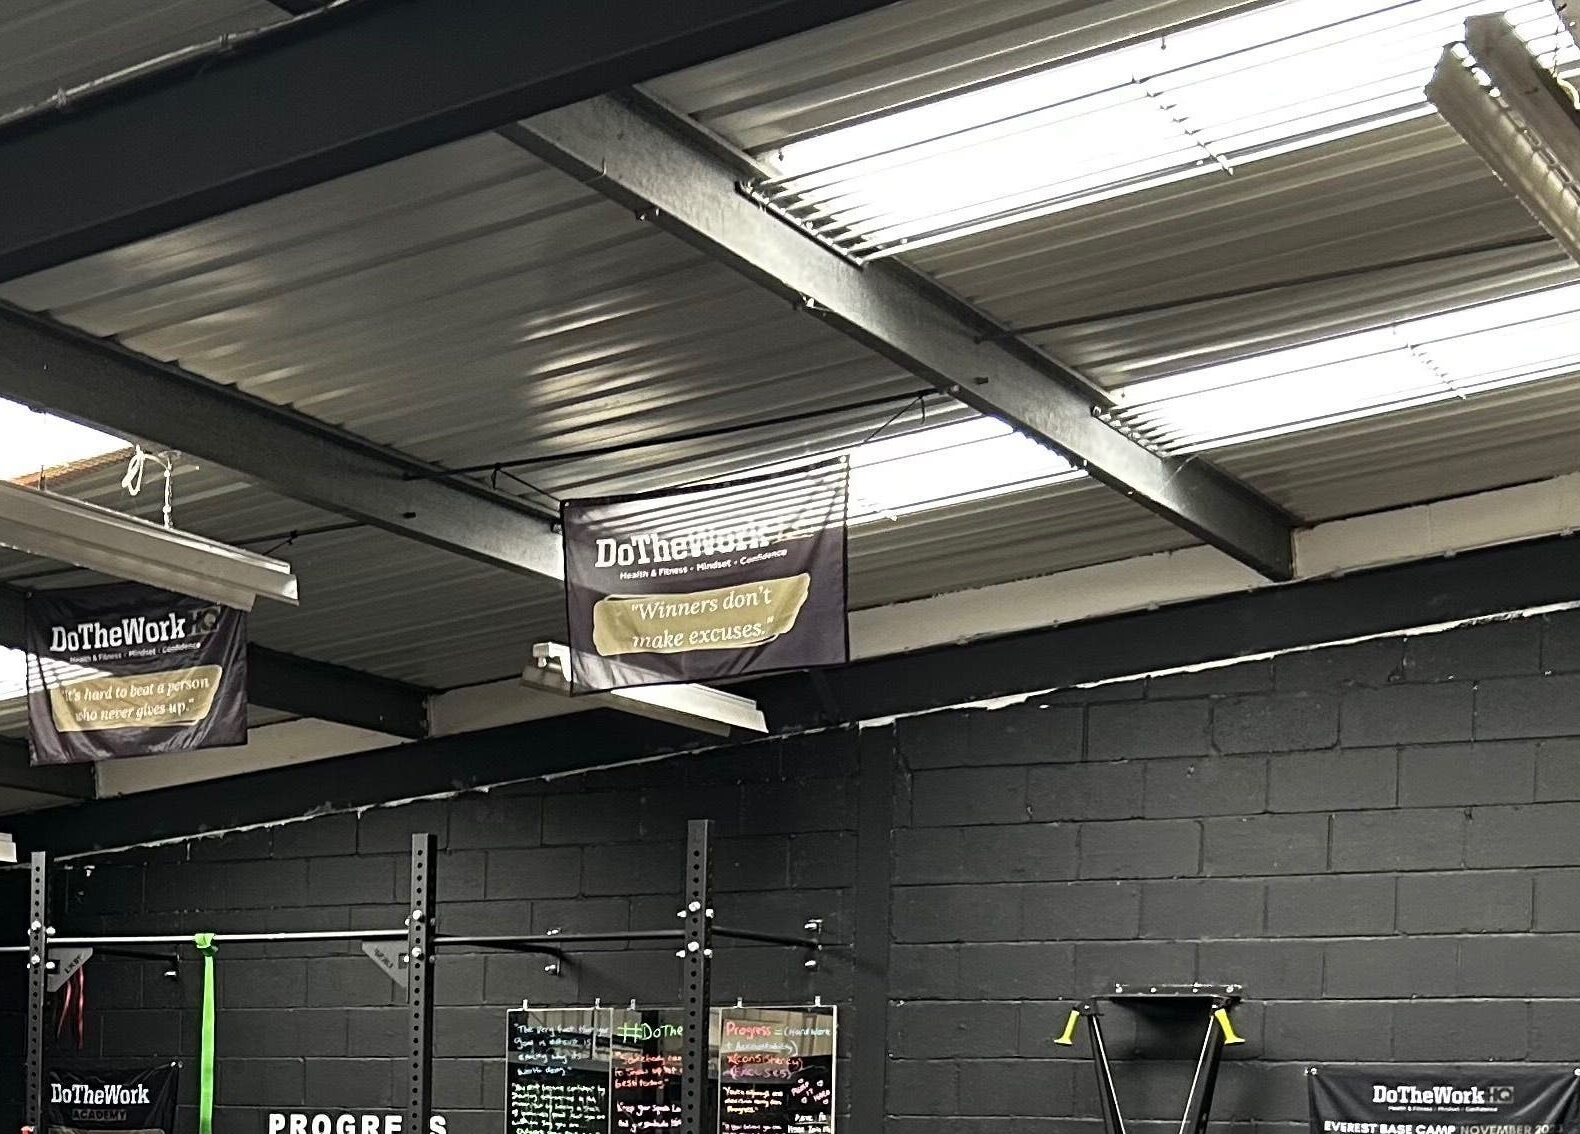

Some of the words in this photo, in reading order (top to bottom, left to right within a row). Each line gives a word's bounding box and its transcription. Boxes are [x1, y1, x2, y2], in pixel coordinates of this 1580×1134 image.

[620, 571, 649, 580] Health
[696, 559, 732, 571] Mindset
[631, 597, 718, 621] "Winners
[722, 585, 773, 610] don't
[50, 612, 186, 653] DoTheWork
[632, 629, 684, 649] make
[688, 615, 774, 645] excuses."
[84, 686, 112, 702] hard
[116, 687, 127, 699] to
[130, 684, 154, 698] beat
[157, 684, 165, 694] a
[167, 677, 210, 697] person
[76, 708, 97, 722] who
[100, 708, 134, 721] never
[136, 704, 166, 720] gives
[169, 698, 195, 716] up."
[617, 1022, 683, 1043] #DoThe
[726, 1021, 771, 1040] Progress
[51, 1083, 150, 1105] DoTheWork
[1373, 1085, 1485, 1105] DoTheWork
[72, 1109, 127, 1121] ACADEMY
[1324, 1120, 1377, 1134] EVEREST
[1380, 1123, 1413, 1134] BASE
[1535, 1124, 1563, 1134] 20
